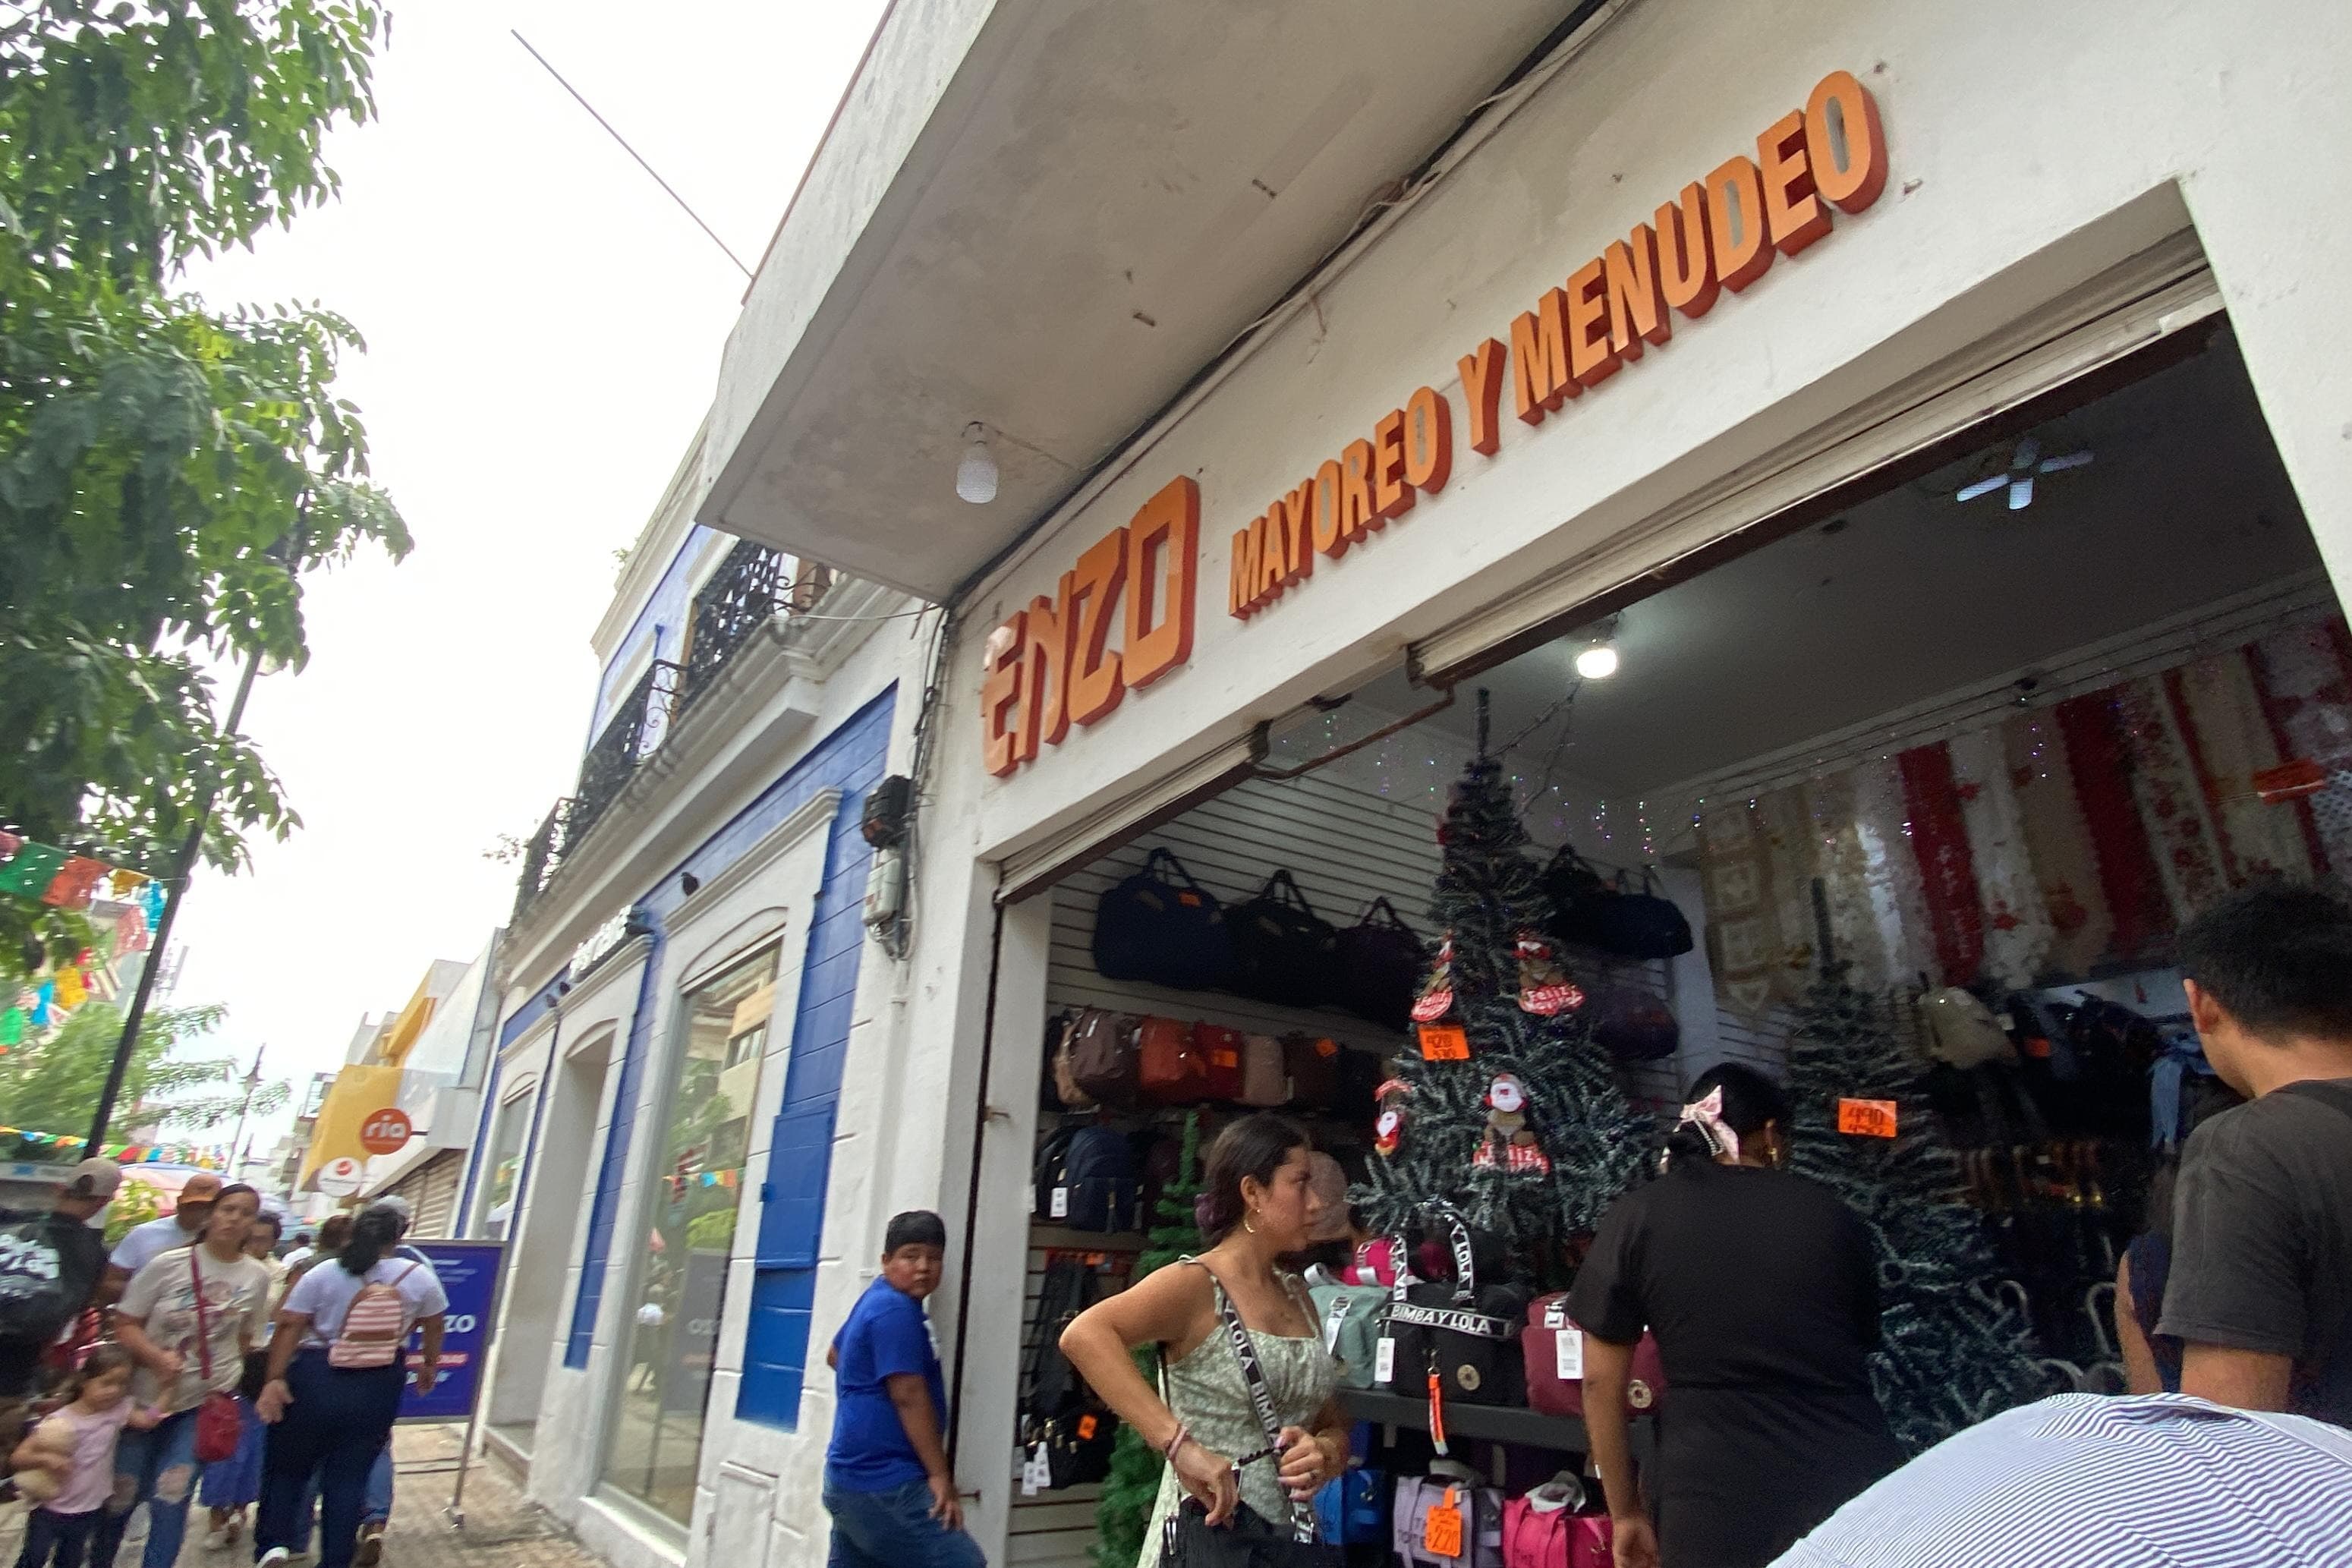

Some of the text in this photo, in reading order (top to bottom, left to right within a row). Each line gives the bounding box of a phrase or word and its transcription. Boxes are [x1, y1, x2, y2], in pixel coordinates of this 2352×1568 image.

[981, 70, 1889, 778] ENZO MAYOREO Y MENUDEO
[365, 1114, 406, 1138] ria
[1456, 1242, 1472, 1283] LOLA
[1390, 1305, 1435, 1324] BIMBA
[1450, 1315, 1493, 1335] LOLA
[1228, 1320, 1255, 1371] LOLA
